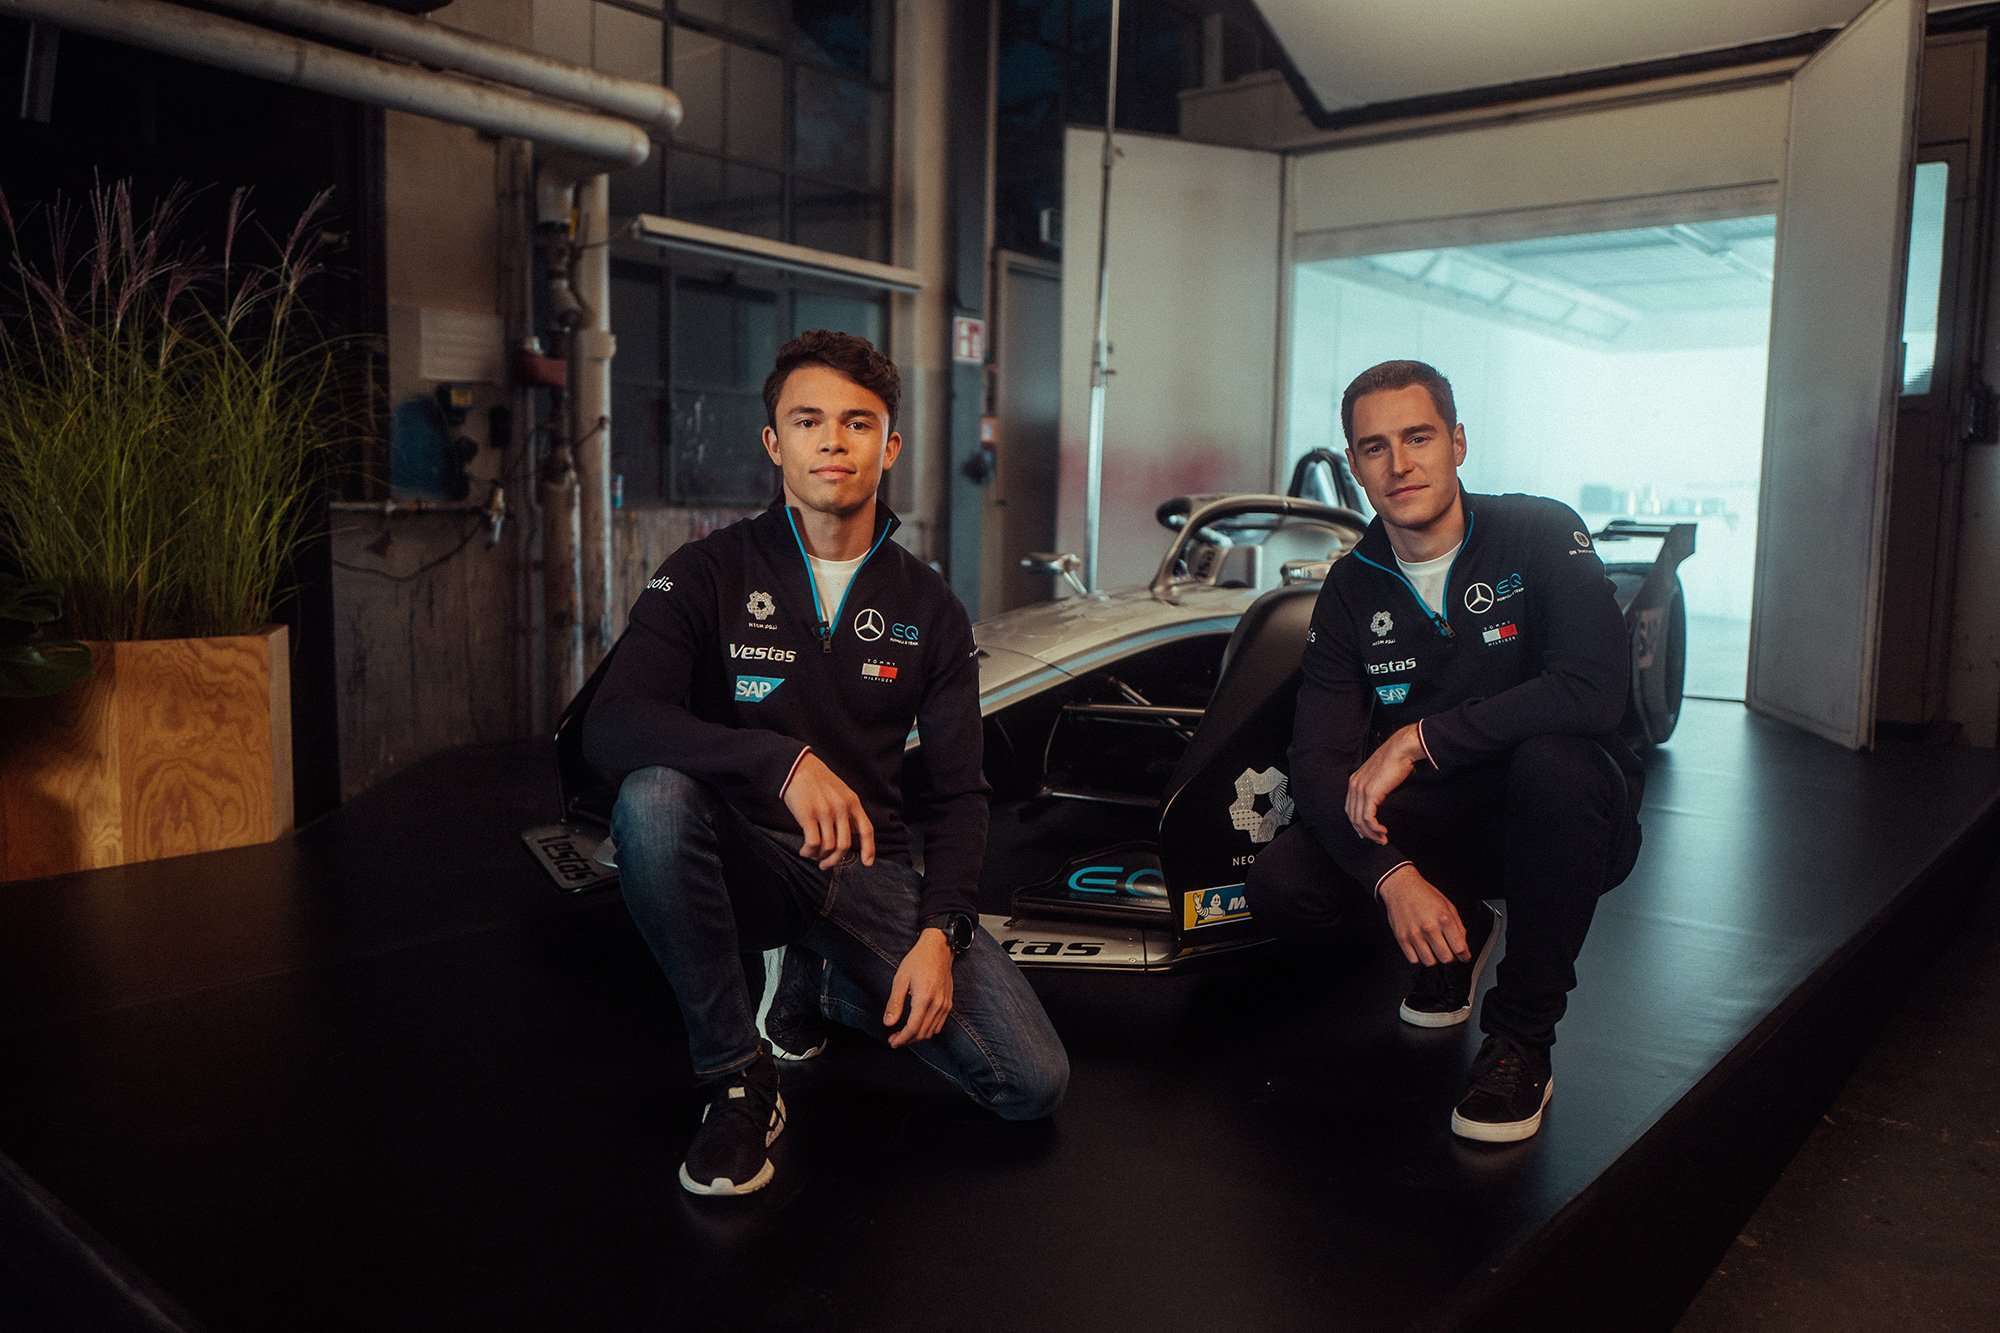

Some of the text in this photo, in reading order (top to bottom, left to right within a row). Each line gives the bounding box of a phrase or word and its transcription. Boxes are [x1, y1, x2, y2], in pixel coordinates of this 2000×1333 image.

[891, 623, 920, 641] EQ
[729, 643, 798, 663] Vestas
[736, 680, 772, 698] SAP
[1380, 687, 1406, 702] SAP
[1001, 938, 1105, 956] tas
